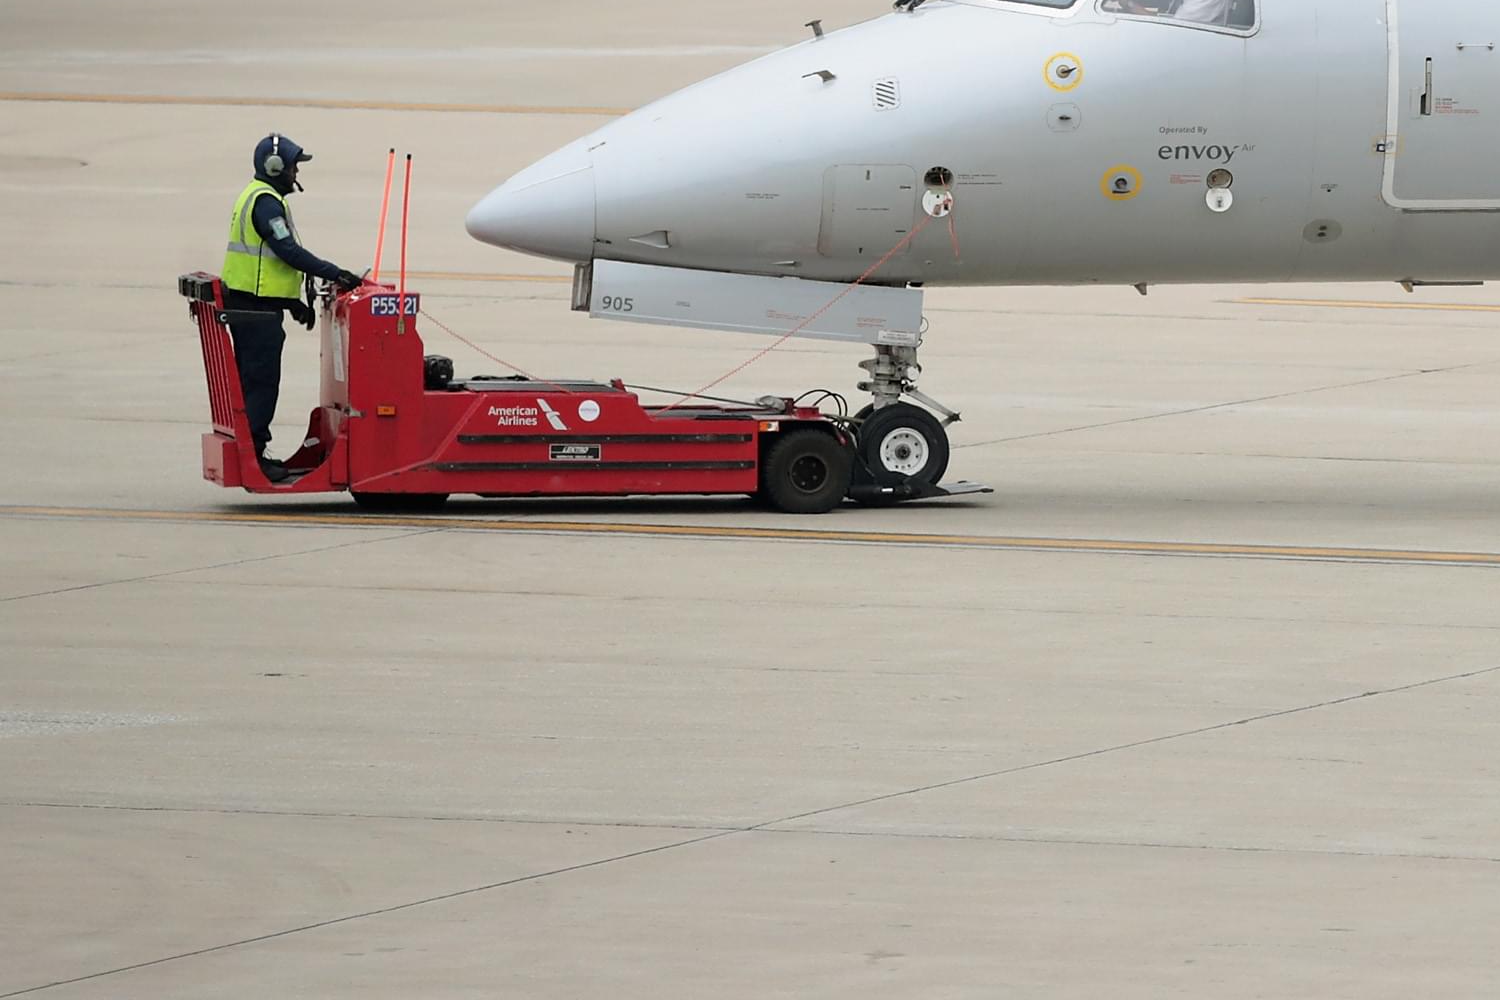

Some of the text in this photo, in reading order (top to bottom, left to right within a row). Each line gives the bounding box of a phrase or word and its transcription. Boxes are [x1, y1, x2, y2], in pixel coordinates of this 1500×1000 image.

[1159, 126, 1195, 135] Operated
[1158, 144, 1256, 164] envoy Air
[602, 295, 633, 312] 905
[488, 405, 537, 415] American
[497, 416, 537, 425] Airlines
